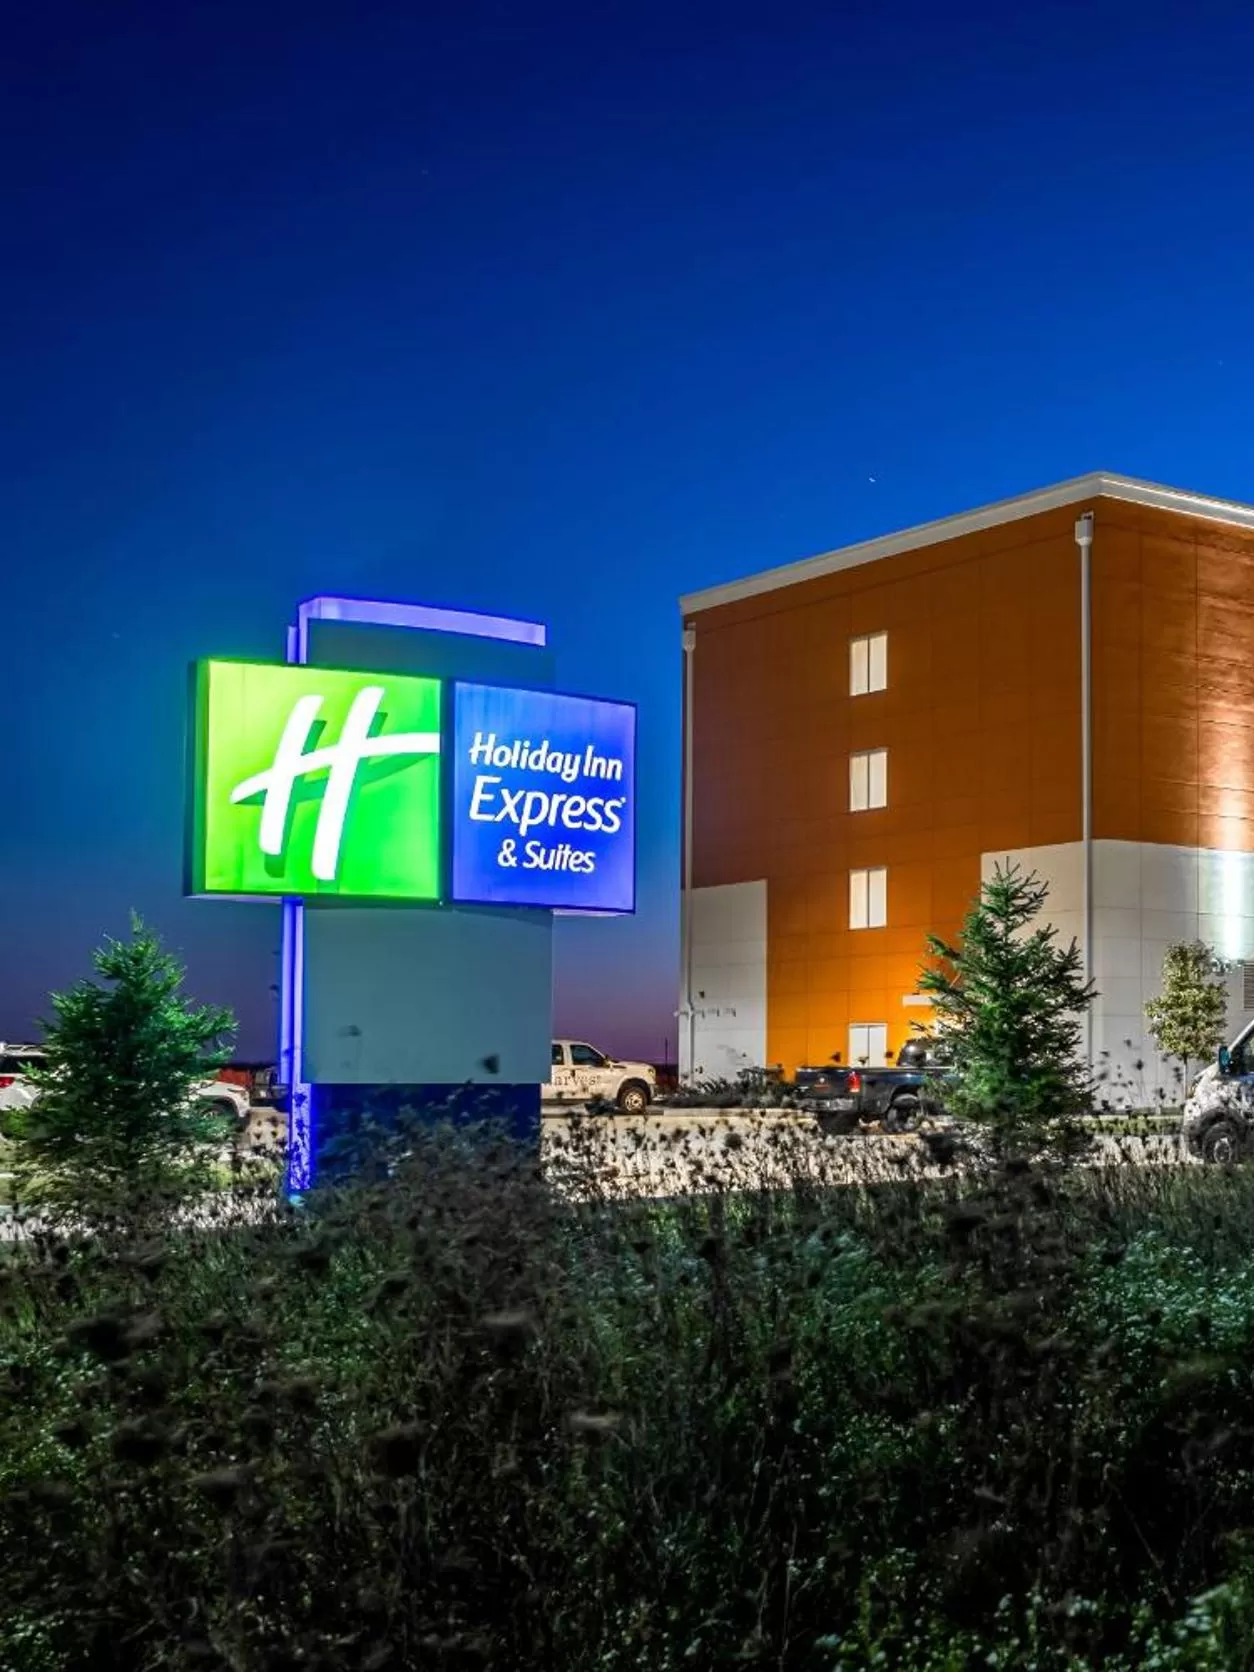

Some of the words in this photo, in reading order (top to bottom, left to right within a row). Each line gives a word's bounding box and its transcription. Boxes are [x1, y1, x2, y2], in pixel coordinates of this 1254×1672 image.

[469, 732, 581, 783] Holiday
[583, 745, 623, 781] Inn
[469, 775, 623, 837] Express
[497, 838, 518, 868] &
[522, 840, 596, 873] Suites
[554, 1075, 602, 1086] arvest
